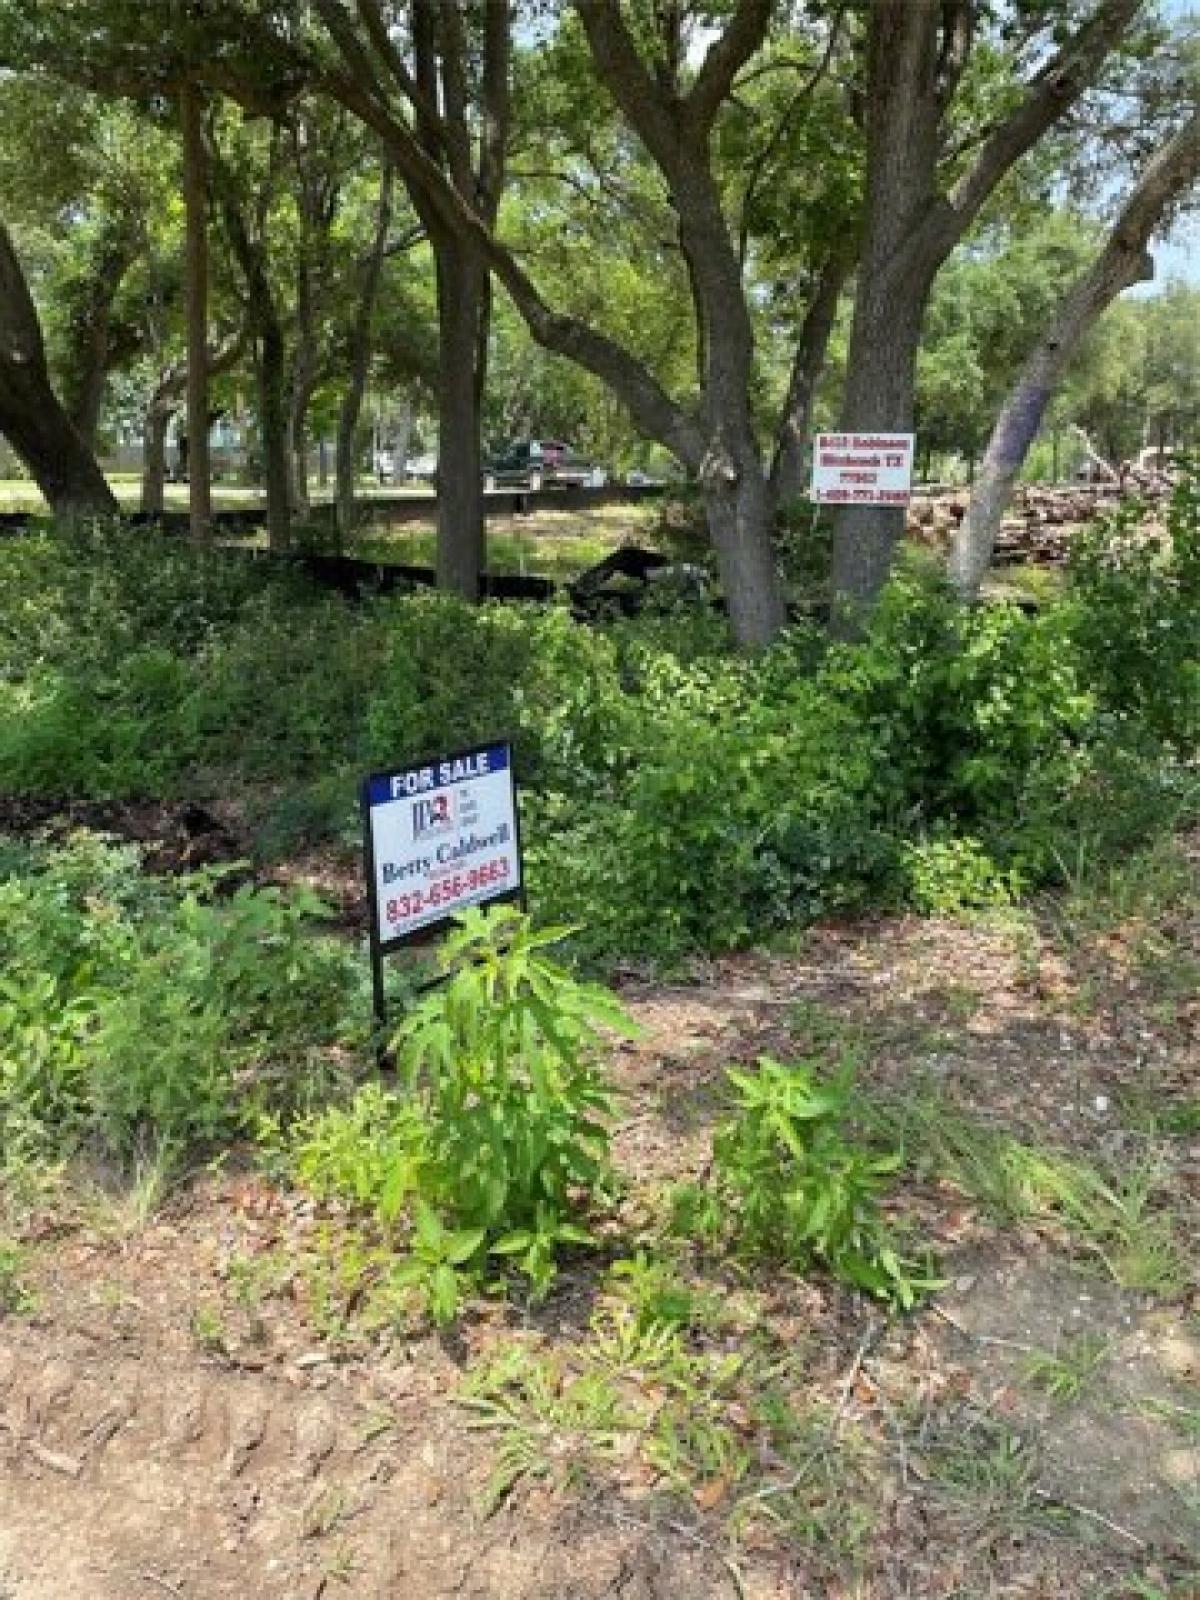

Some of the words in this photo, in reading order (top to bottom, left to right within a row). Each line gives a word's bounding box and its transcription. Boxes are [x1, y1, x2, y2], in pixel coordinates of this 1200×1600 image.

[391, 768, 434, 798] FOR
[439, 752, 491, 786] SALE
[436, 822, 511, 863] Caldwell
